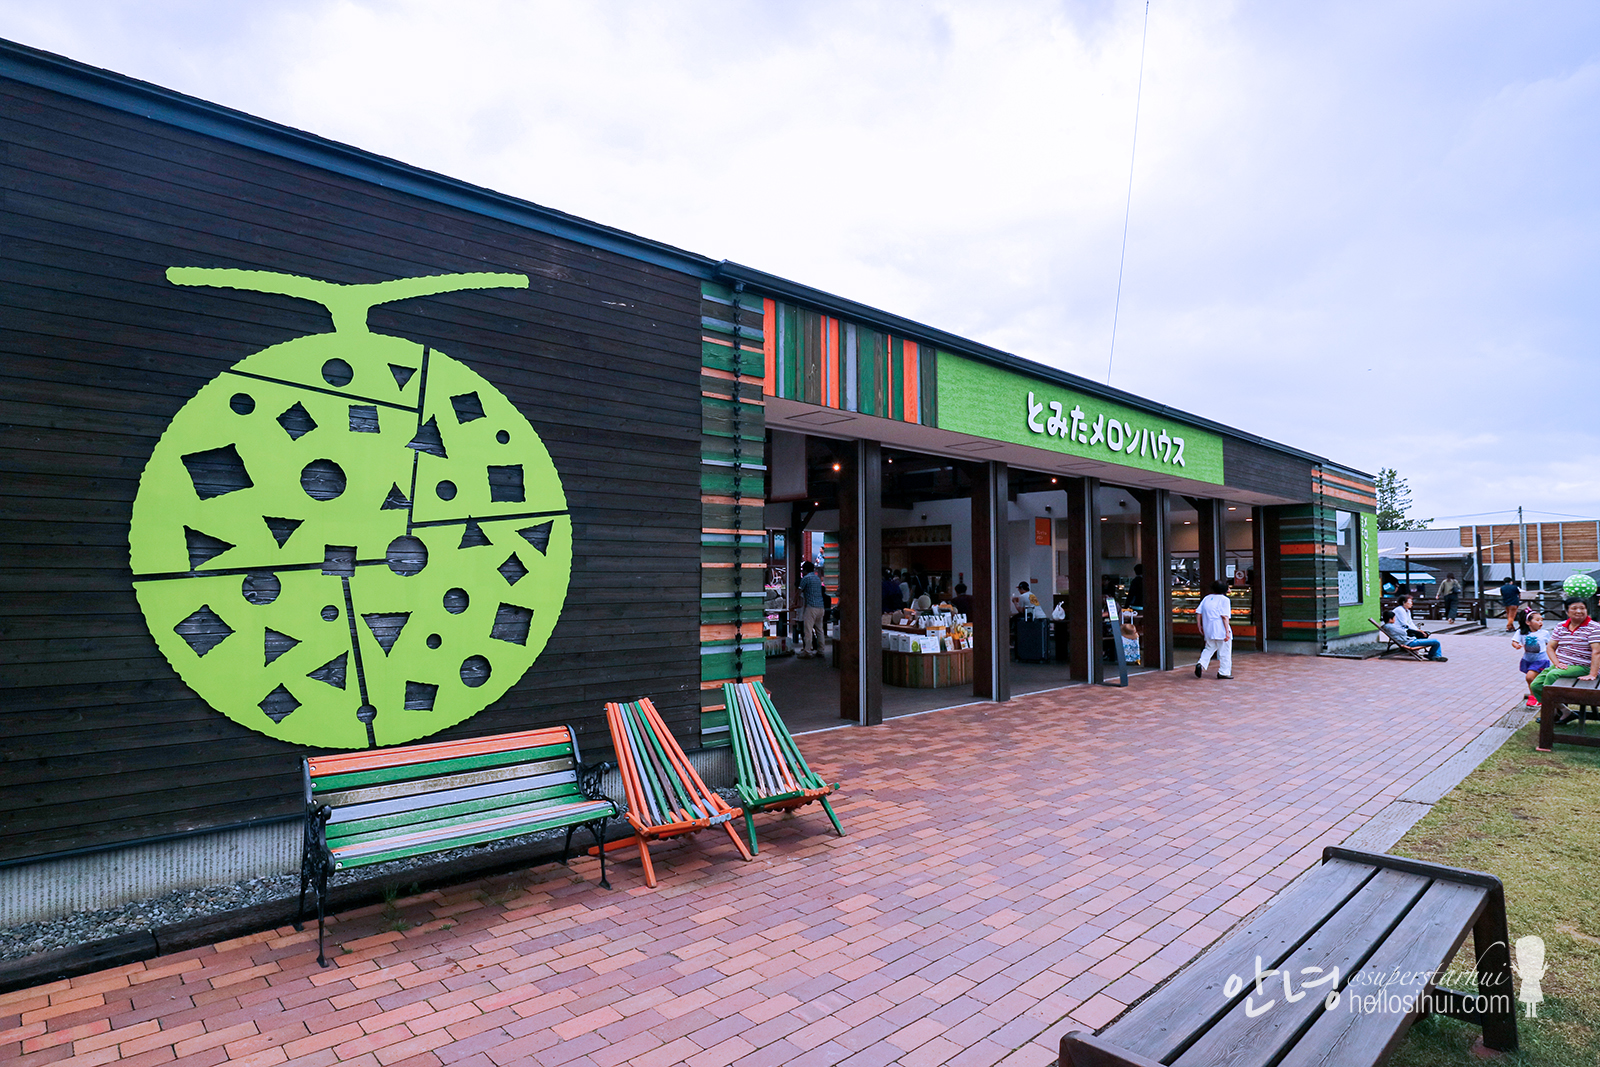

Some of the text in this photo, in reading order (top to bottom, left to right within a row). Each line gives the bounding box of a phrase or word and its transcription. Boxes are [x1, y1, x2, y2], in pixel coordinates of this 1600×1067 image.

[1027, 391, 1186, 467] とみたメロンハウス
